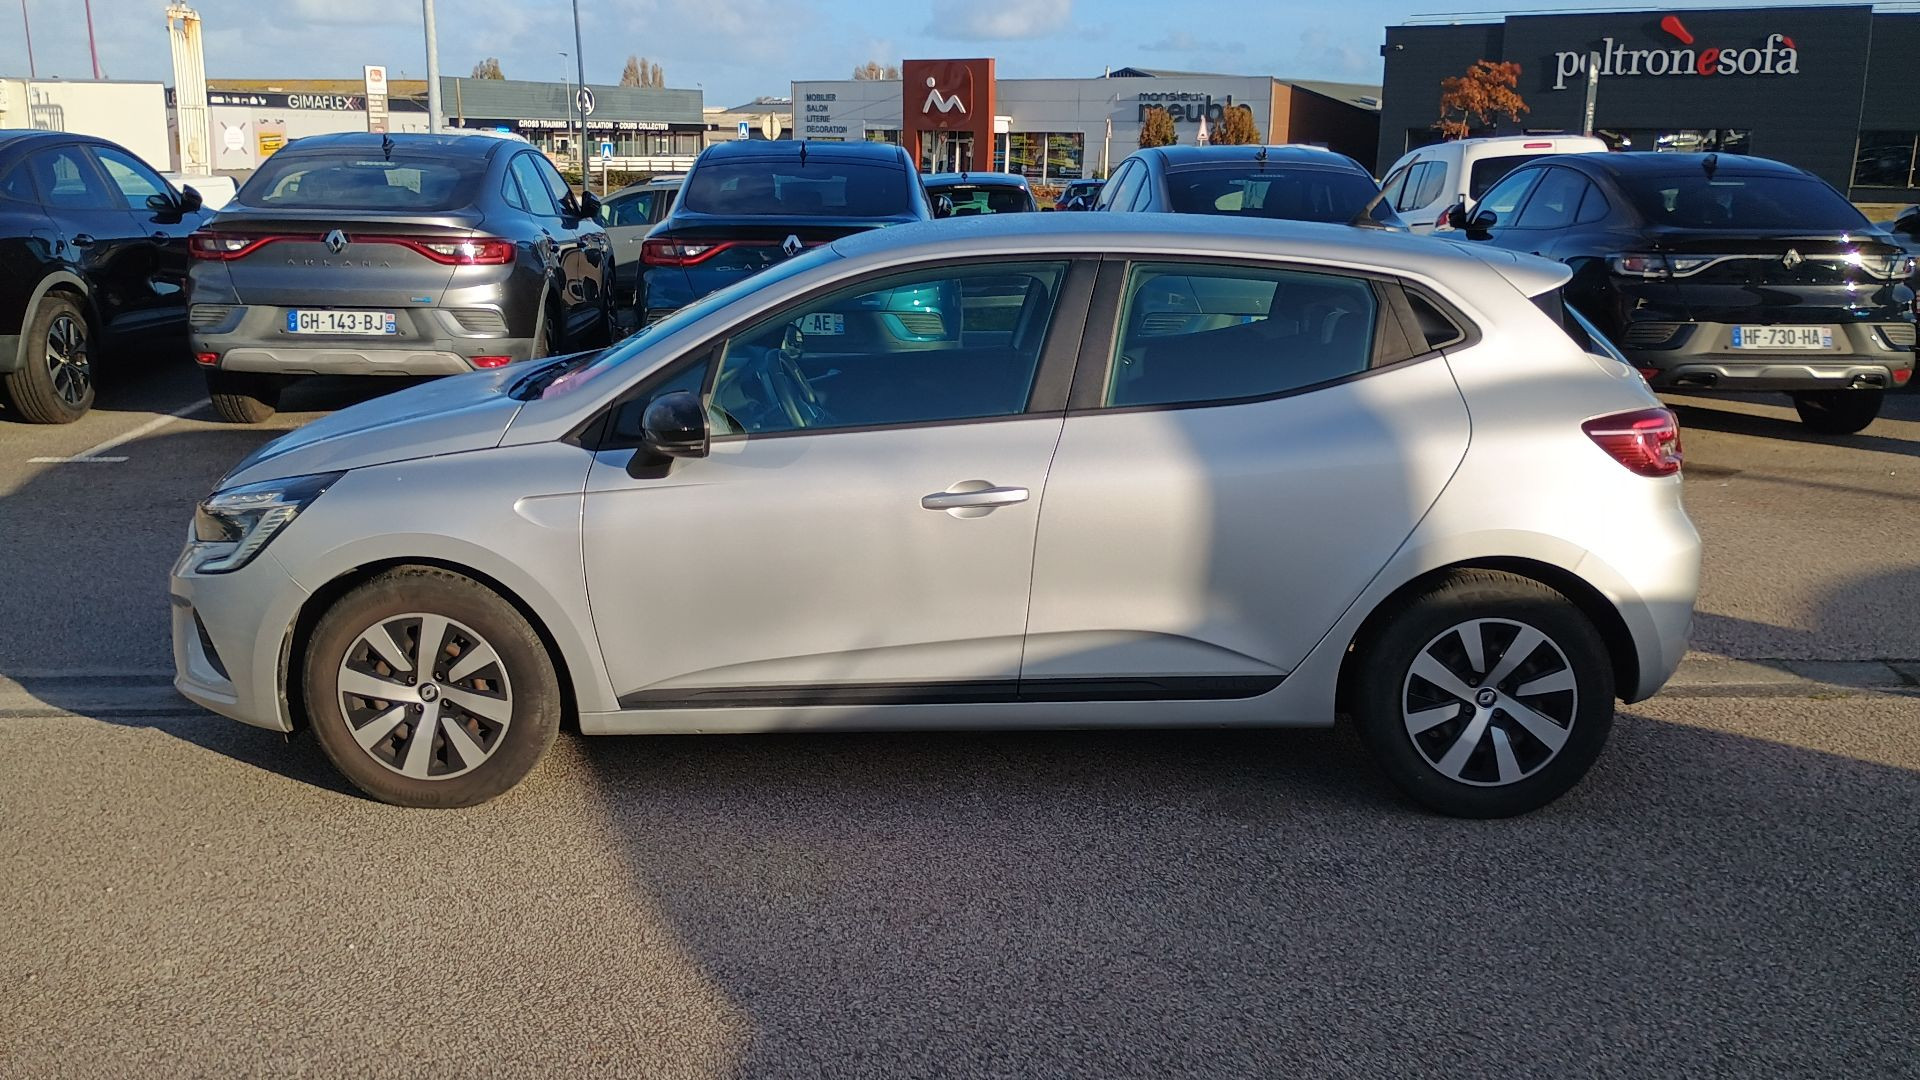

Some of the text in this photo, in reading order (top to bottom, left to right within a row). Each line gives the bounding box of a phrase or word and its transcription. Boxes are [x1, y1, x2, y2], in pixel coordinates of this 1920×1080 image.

[288, 95, 354, 110] GIMAFLEX
[1139, 91, 1204, 101] monsieur
[1139, 95, 1252, 122] meub
[519, 120, 539, 128] CROSS
[540, 120, 567, 128] TRAINING
[576, 121, 613, 129] MCULATION
[300, 313, 384, 330] GH-143-BJ
[1743, 329, 1820, 345] HF-730-HA
